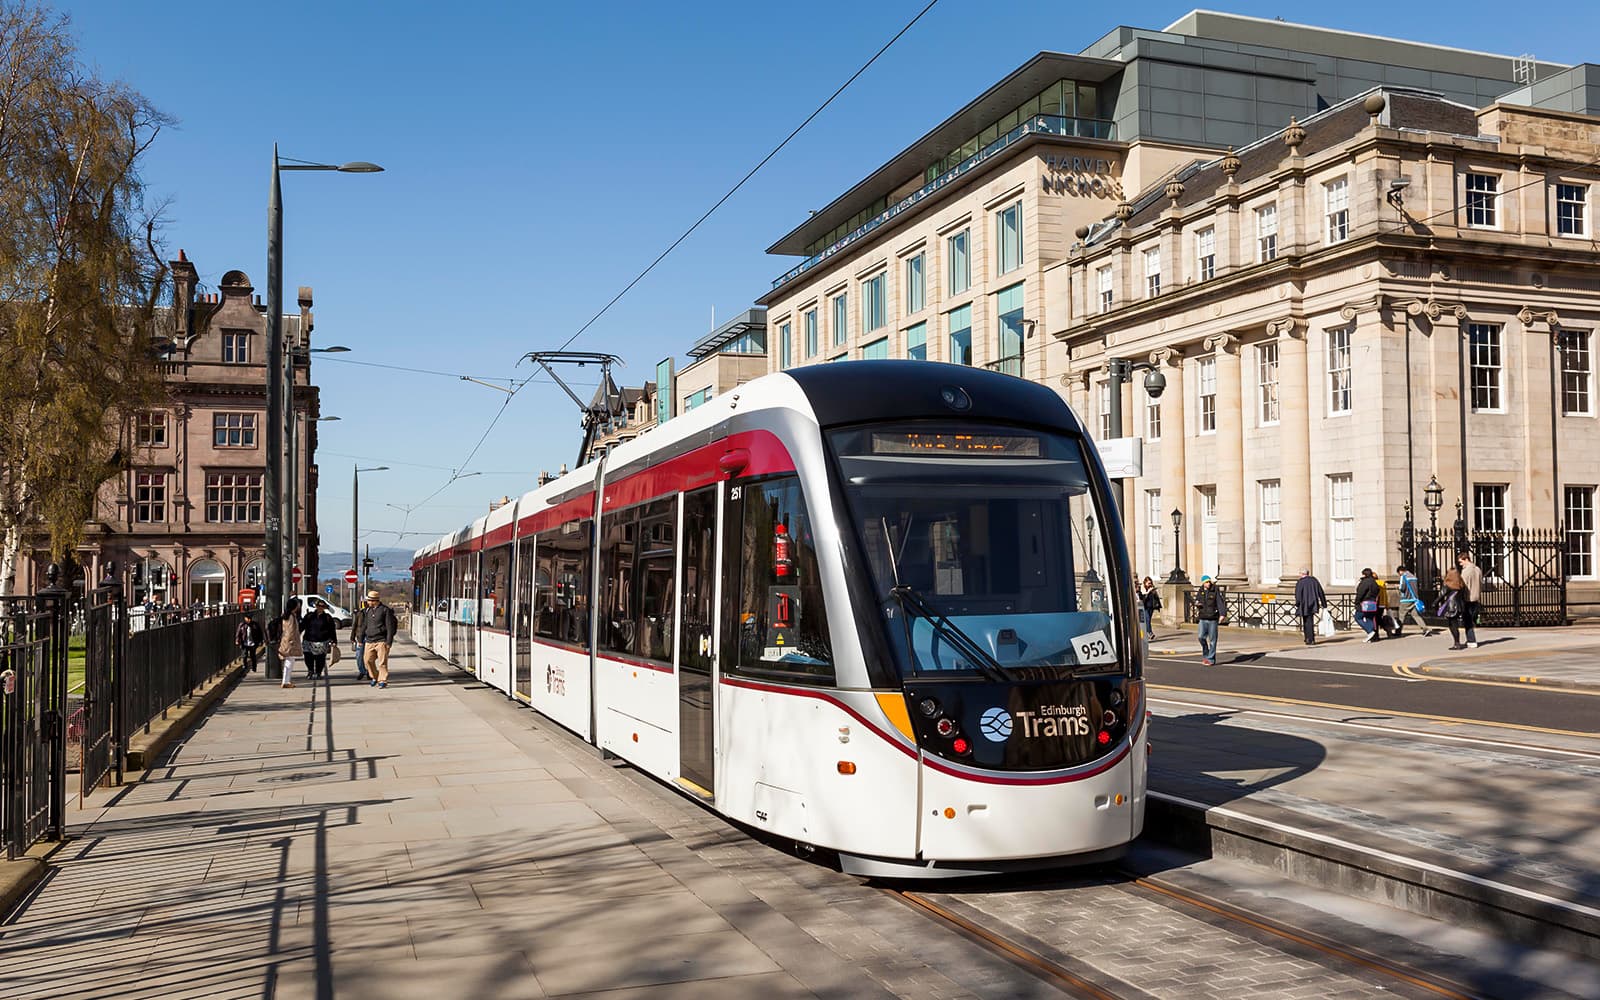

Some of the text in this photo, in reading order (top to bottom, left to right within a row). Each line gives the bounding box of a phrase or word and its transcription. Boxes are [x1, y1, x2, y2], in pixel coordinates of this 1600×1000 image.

[1046, 155, 1115, 174] HARVEY
[1081, 640, 1108, 660] 952
[1040, 704, 1087, 717] Edinburgh
[1016, 711, 1090, 738] Trams
